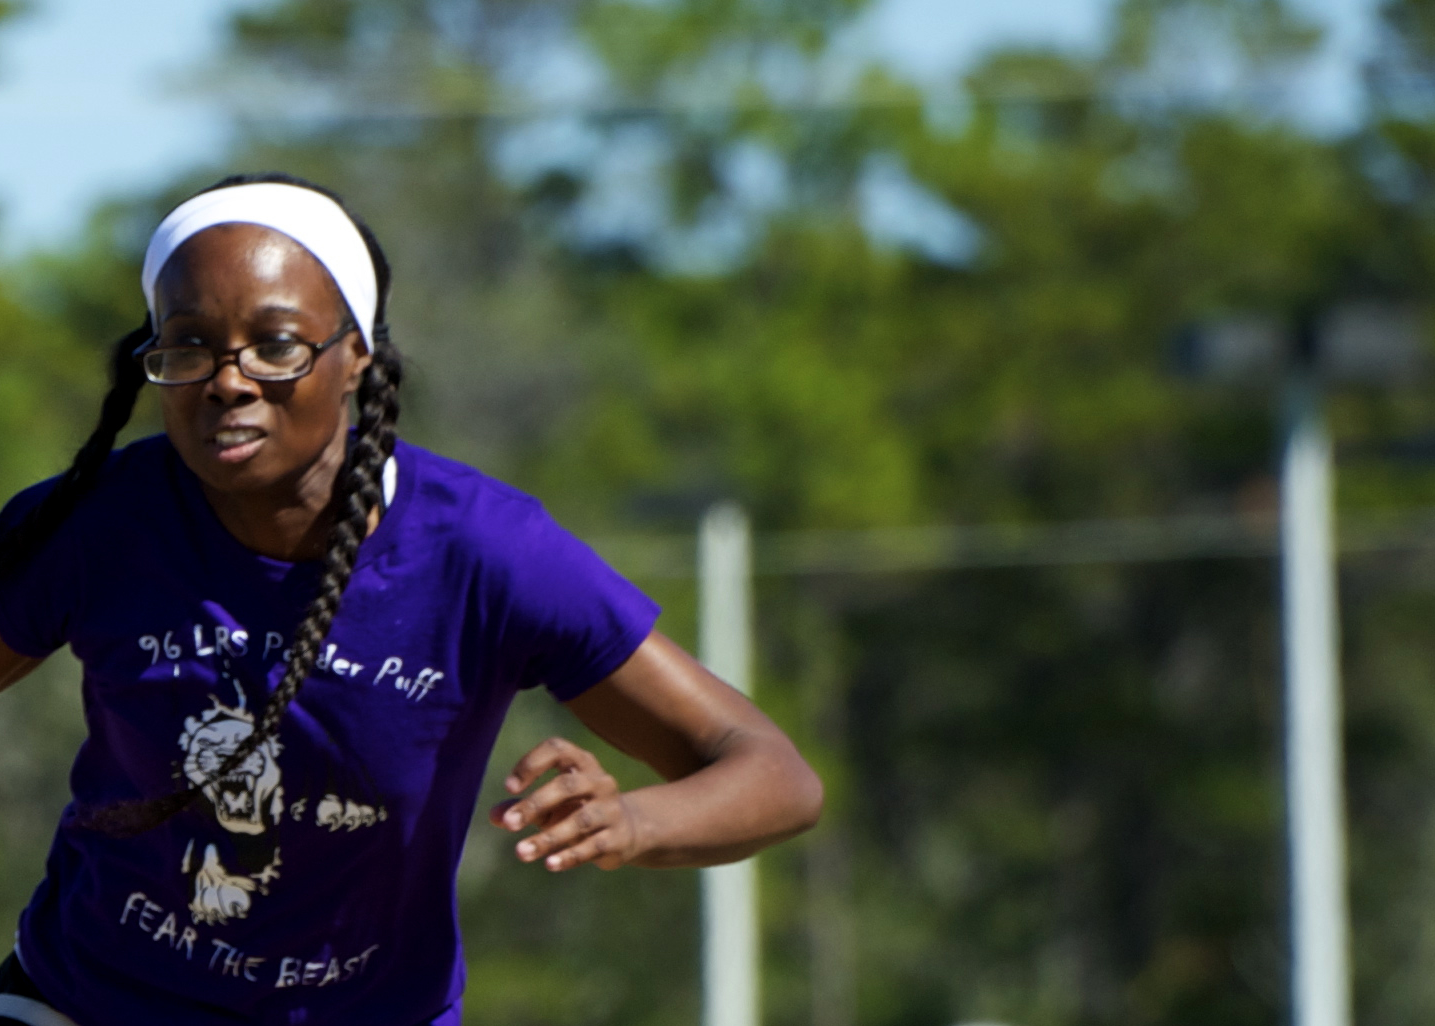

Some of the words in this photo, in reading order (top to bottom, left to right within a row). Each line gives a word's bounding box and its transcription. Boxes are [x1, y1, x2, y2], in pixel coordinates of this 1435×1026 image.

[138, 630, 182, 666] 96
[193, 624, 250, 659] LRS
[373, 655, 445, 703] Puff
[119, 891, 199, 961] FEAR
[208, 937, 267, 982] THE
[273, 943, 381, 989] BEAST
